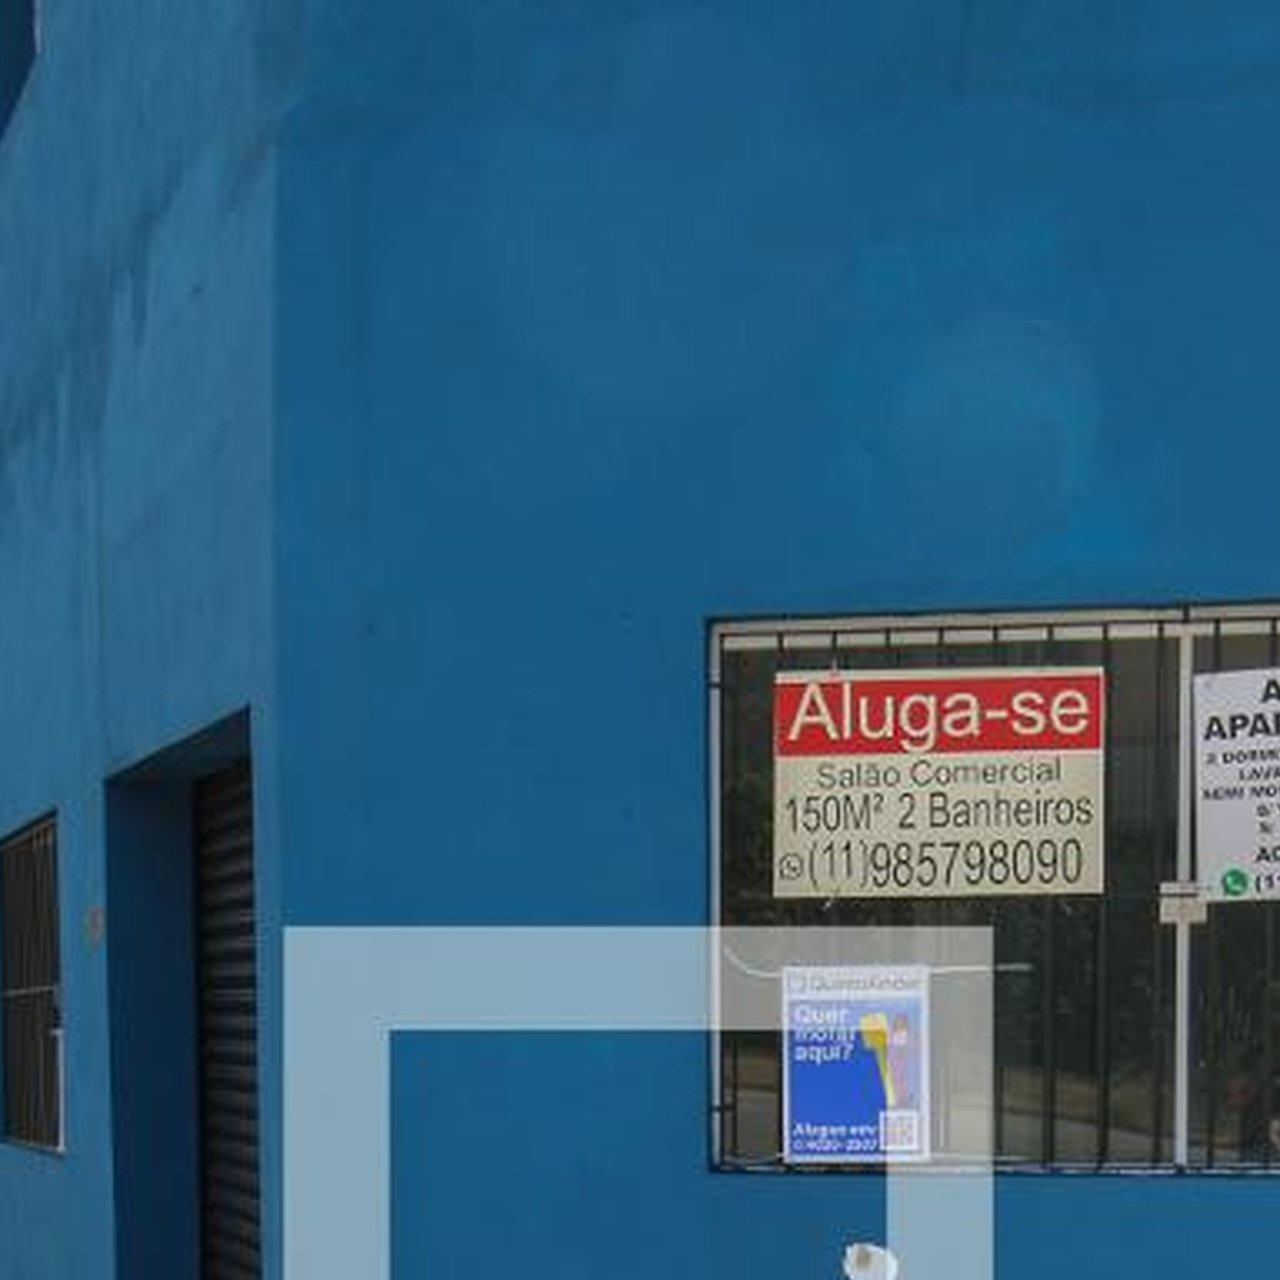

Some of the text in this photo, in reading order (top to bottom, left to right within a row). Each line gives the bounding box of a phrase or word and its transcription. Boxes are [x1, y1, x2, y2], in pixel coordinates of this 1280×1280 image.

[788, 681, 1090, 753] Aluga-se
[817, 756, 1061, 789] Salão Comercial
[898, 793, 916, 830] 2
[928, 789, 1094, 829] Banheiros
[794, 1004, 850, 1025] Quer
